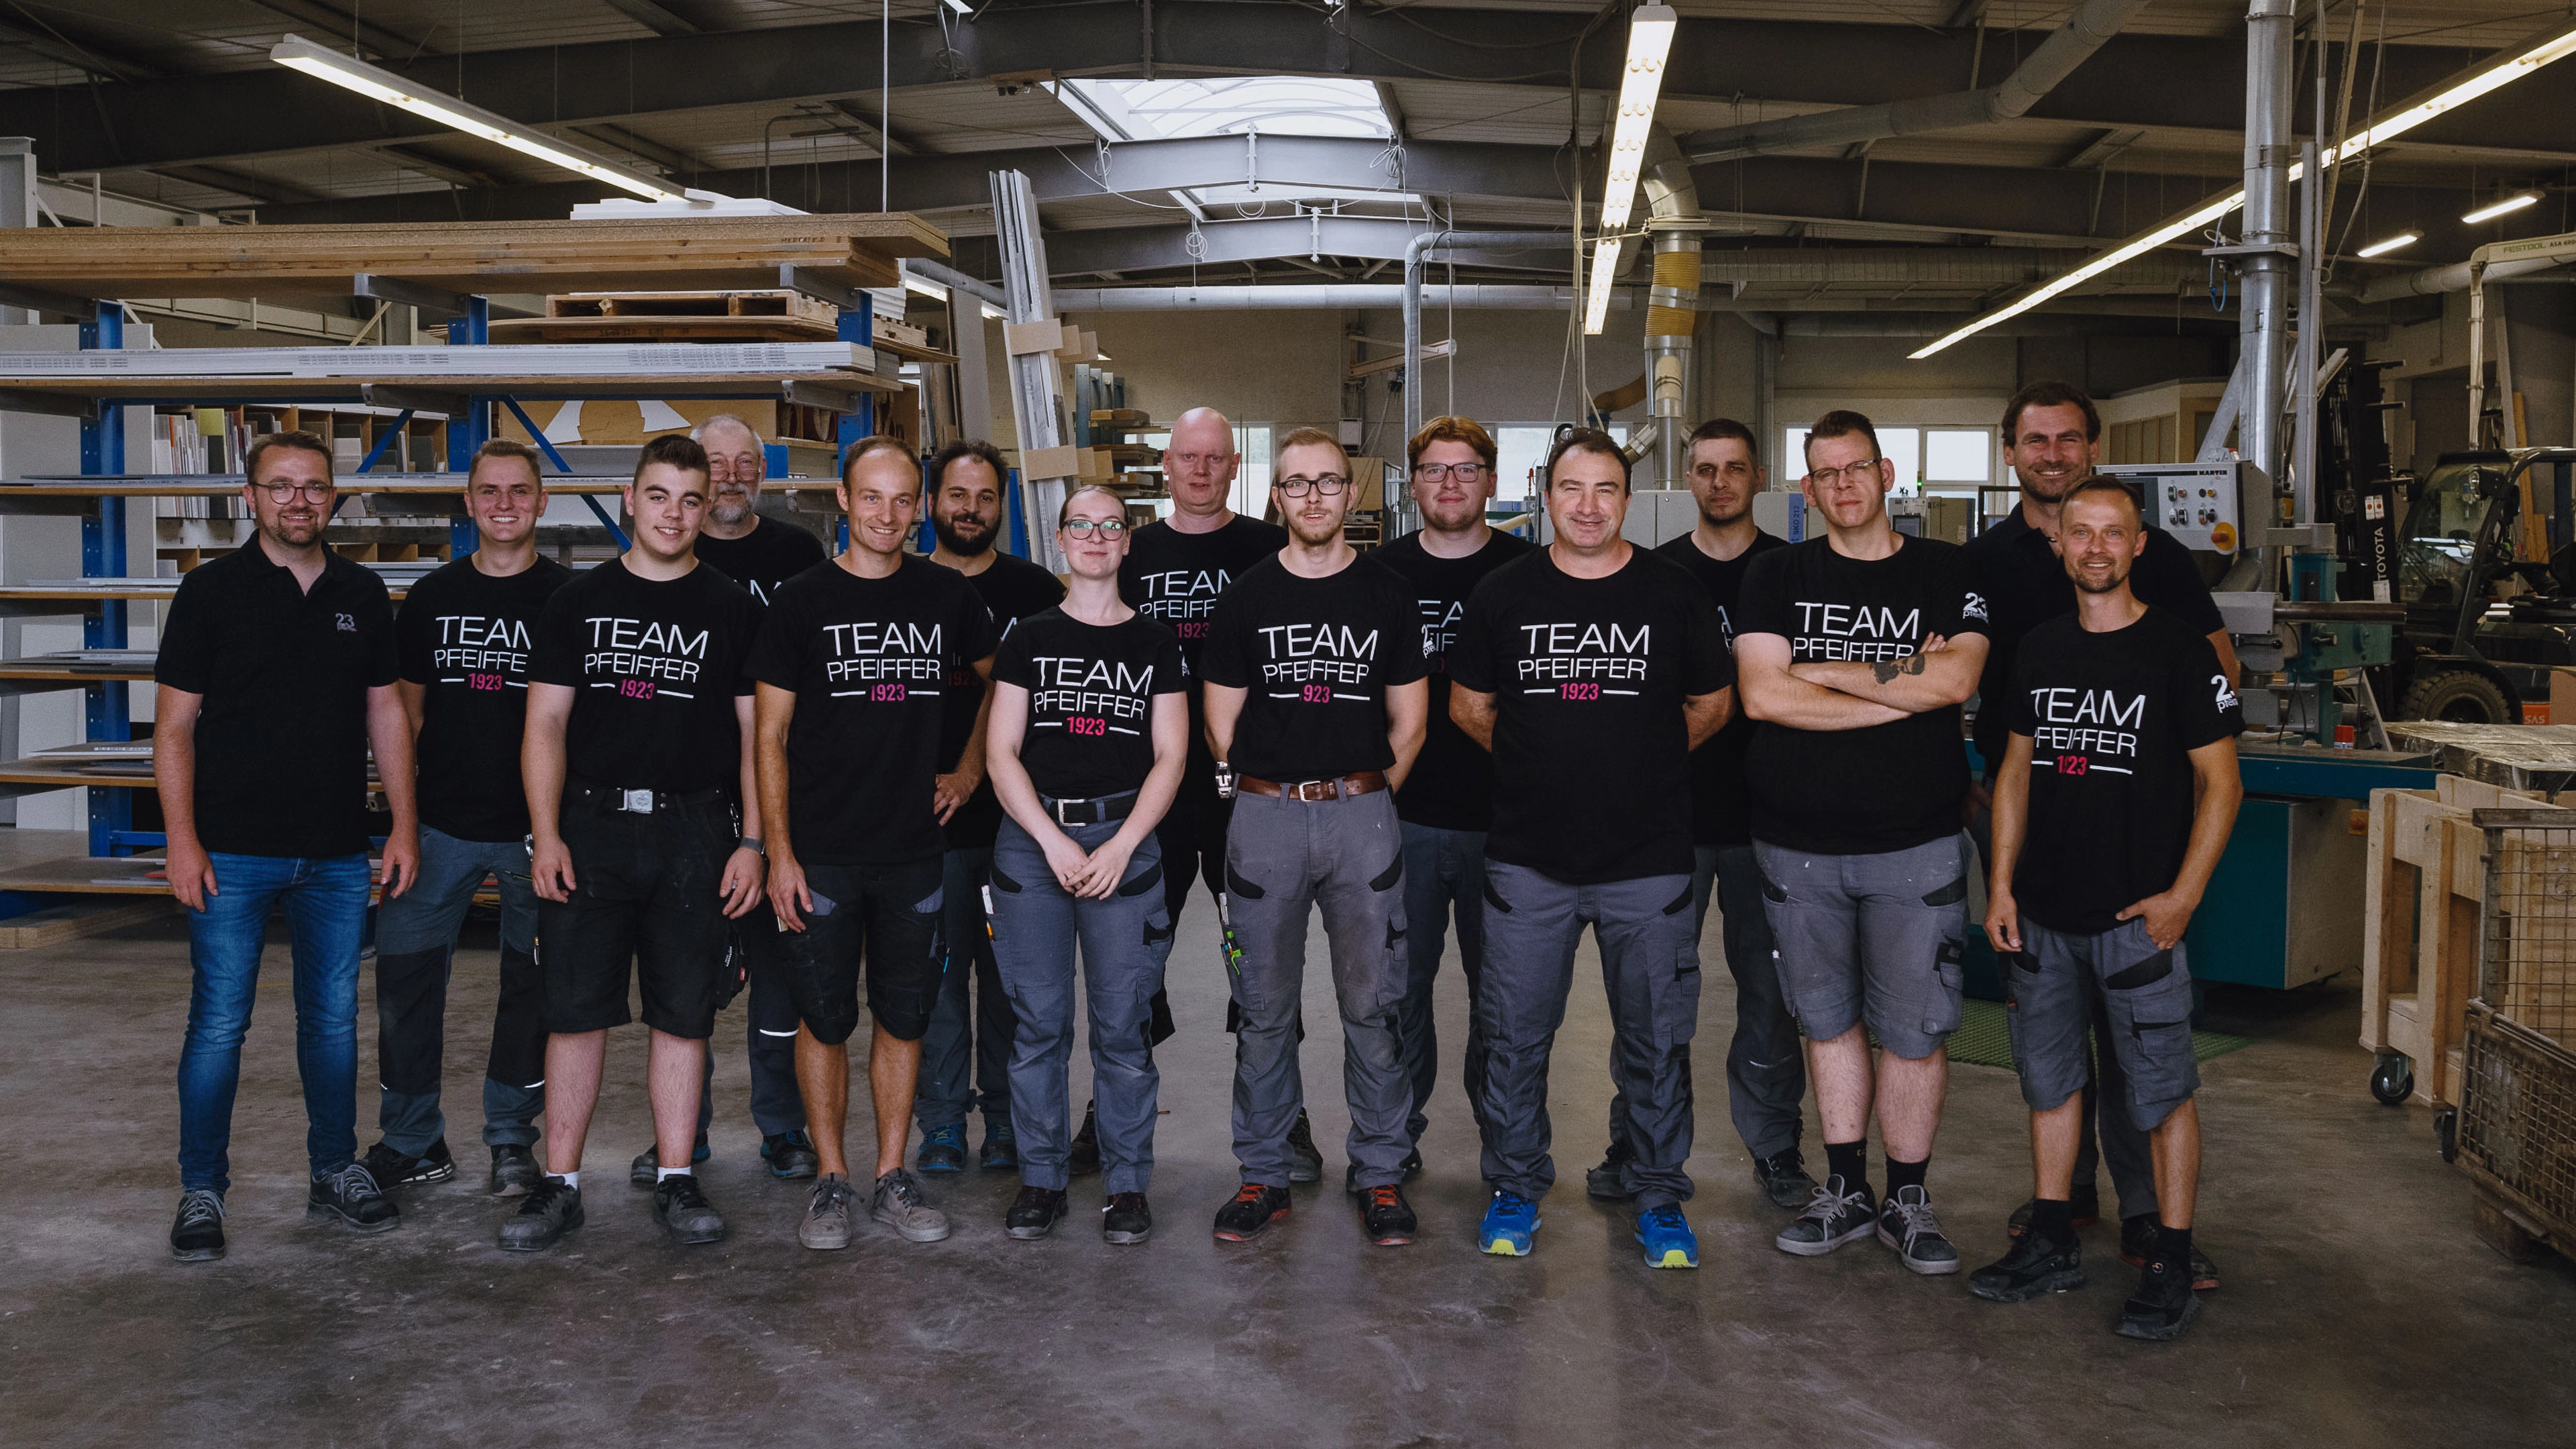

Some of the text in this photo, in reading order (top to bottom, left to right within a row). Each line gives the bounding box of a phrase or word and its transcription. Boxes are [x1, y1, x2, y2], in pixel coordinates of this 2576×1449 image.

[2504, 242, 2546, 254] FESTOOL
[2374, 527, 2387, 580] TOYOTA
[335, 613, 355, 628] 23
[1140, 598, 1217, 619] PFEIFF
[1795, 602, 1919, 639] TEAM
[586, 618, 708, 659] TEAM
[823, 623, 941, 655] TEAM
[1258, 624, 1379, 661] TEAM
[1521, 623, 1649, 655] TEAM
[435, 649, 529, 672] PFEIFFE
[585, 653, 699, 684] PFEIFFER
[827, 659, 940, 682] PFEIFFER
[1518, 658, 1647, 680] PFEIFFER
[468, 673, 502, 690] 1923
[621, 679, 655, 700] 1923
[1033, 657, 1154, 696] TEAM
[871, 684, 905, 702] 1923
[1560, 682, 1599, 700] 1923
[1034, 690, 1146, 720] PFEIFFER
[2031, 688, 2146, 729] TEAM
[1067, 716, 1106, 736] 1923
[2034, 727, 2137, 757] FEIFFER
